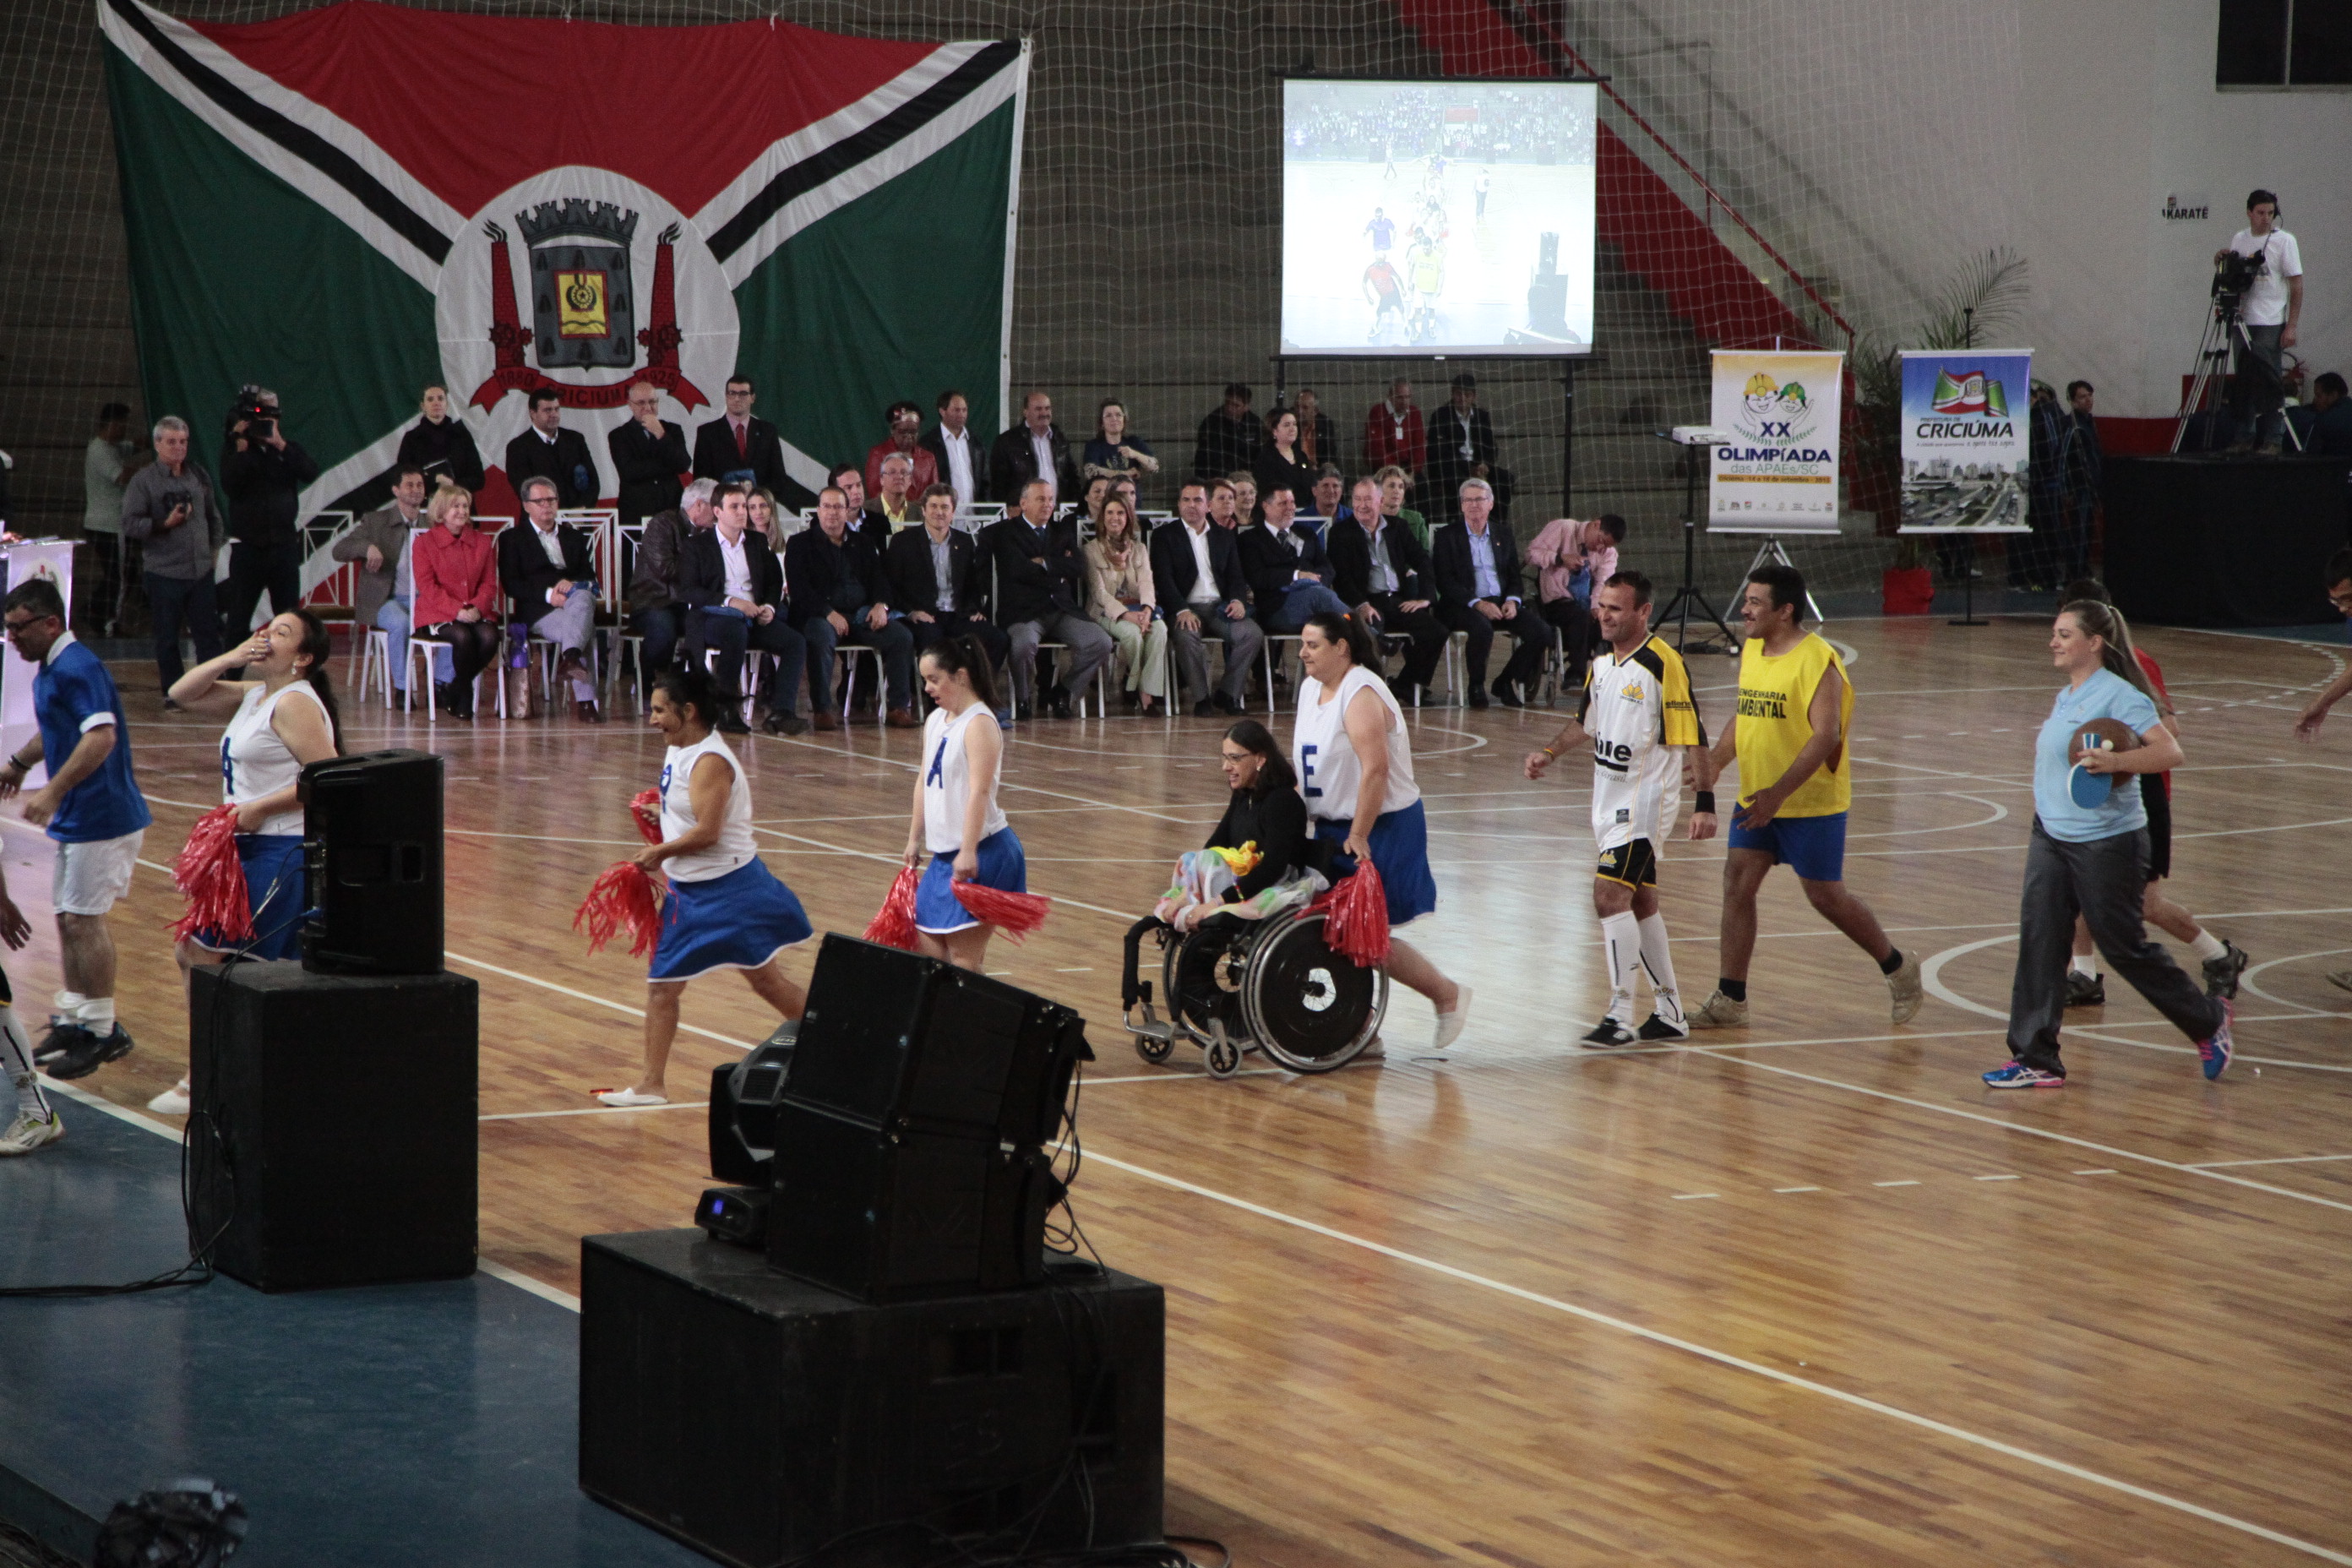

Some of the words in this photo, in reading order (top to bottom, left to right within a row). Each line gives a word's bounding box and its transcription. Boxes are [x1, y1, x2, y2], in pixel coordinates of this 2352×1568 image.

[546, 383, 630, 406] RICIUM
[1761, 422, 1791, 438] XX
[1916, 420, 2013, 438] CRICIÚMA
[1731, 464, 1751, 473] das
[1756, 464, 1819, 475] APAEs/SC
[927, 737, 947, 788] A
[1302, 745, 1323, 798] E
